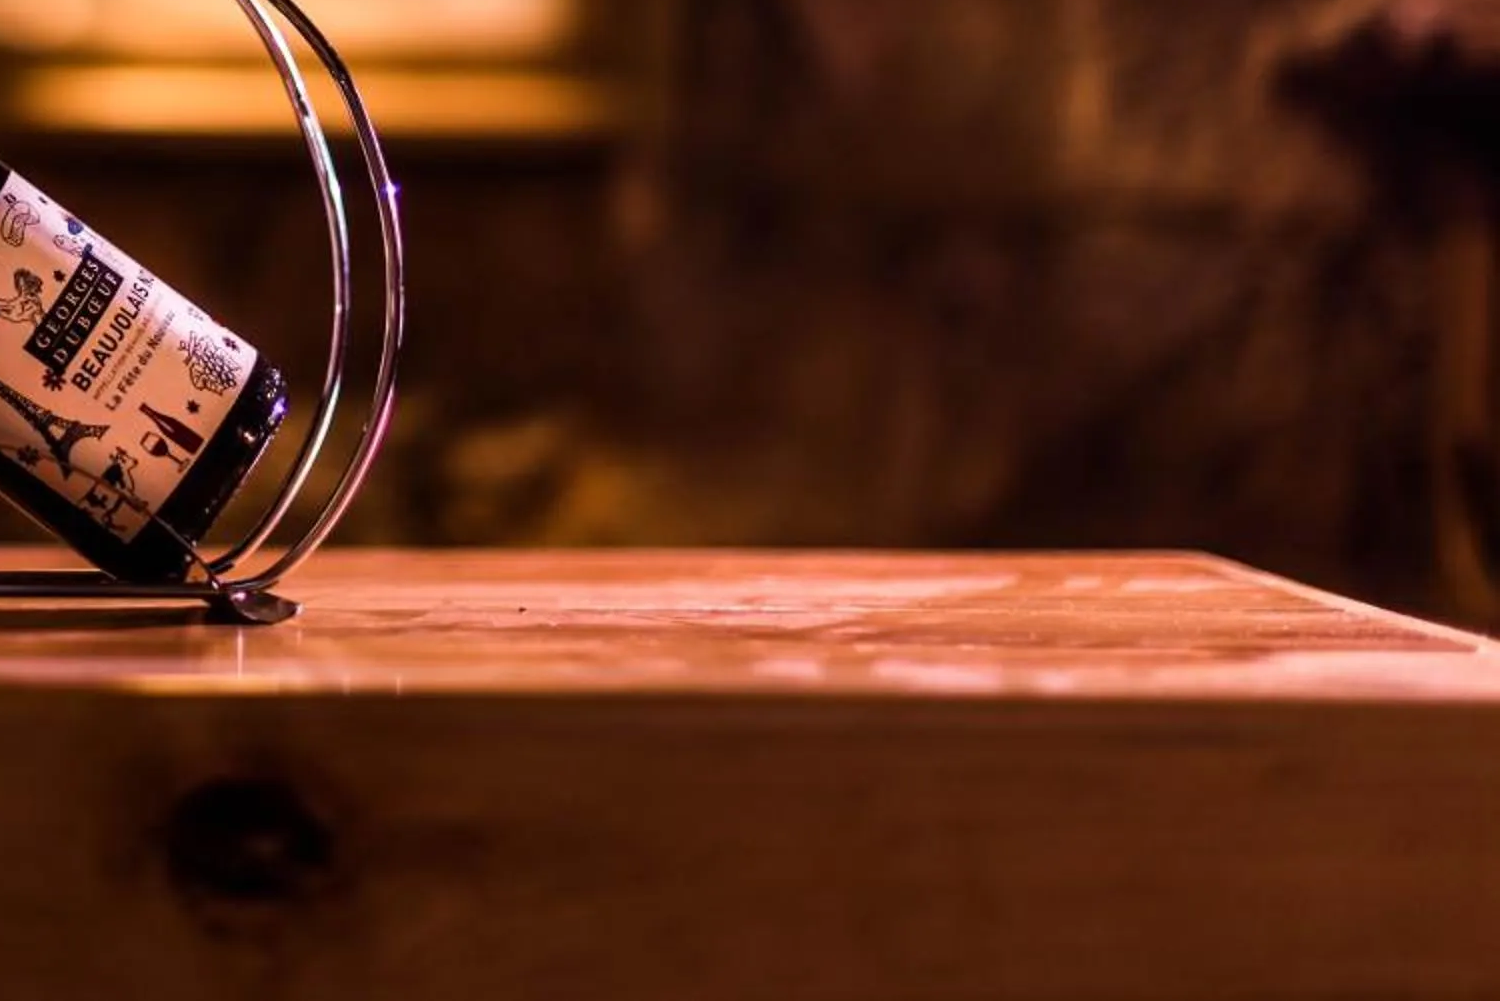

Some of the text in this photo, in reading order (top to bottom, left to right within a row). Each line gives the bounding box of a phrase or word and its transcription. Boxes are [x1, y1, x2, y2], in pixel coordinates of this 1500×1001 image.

[36, 260, 100, 349] GEORGES
[52, 272, 118, 365] DUBŒUF
[71, 282, 150, 392] BEAUJOLAIS
[105, 394, 123, 411] La
[117, 366, 142, 394] Fête
[138, 350, 153, 366] du
